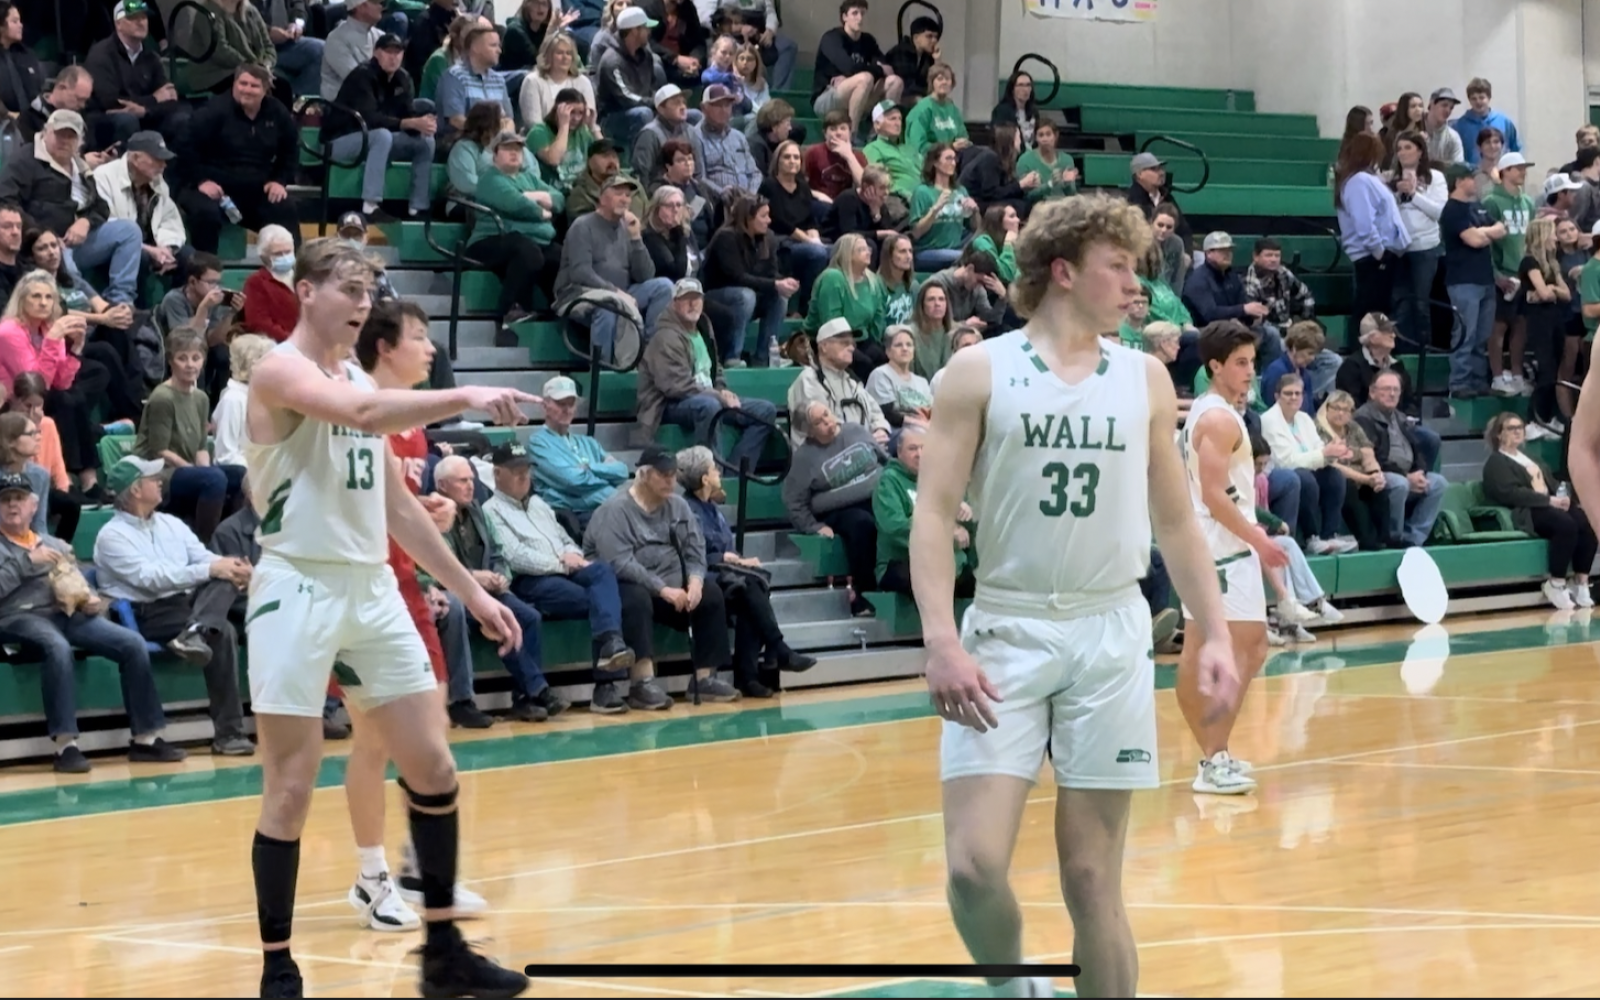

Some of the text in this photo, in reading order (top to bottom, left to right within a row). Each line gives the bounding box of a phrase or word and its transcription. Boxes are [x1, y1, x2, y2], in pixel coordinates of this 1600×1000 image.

[1020, 413, 1126, 451] WALL
[346, 447, 374, 490] 13
[1039, 461, 1100, 518] 33
